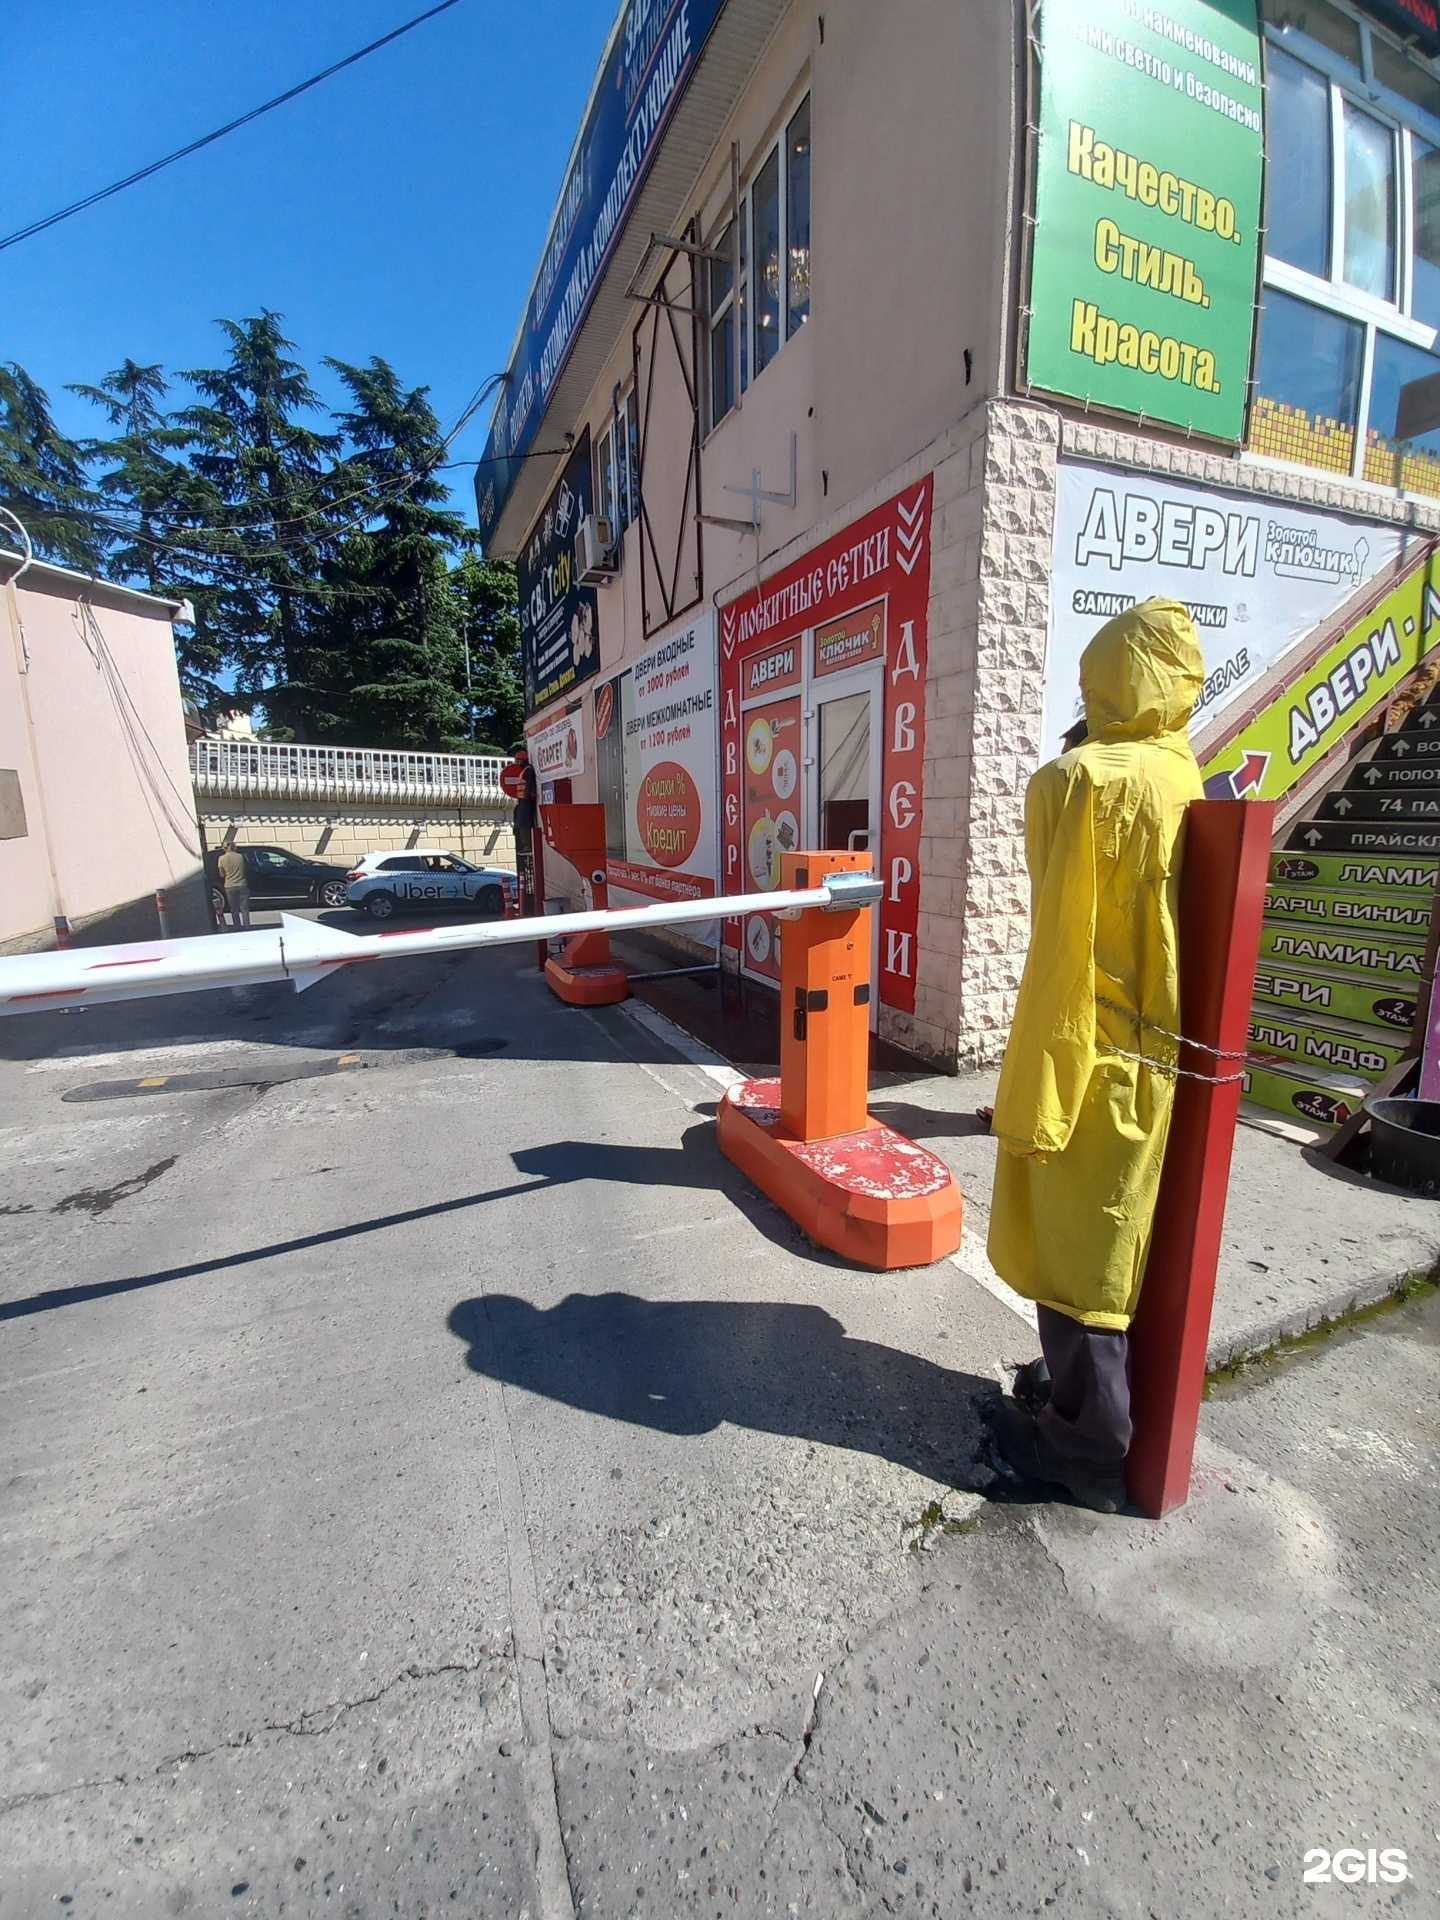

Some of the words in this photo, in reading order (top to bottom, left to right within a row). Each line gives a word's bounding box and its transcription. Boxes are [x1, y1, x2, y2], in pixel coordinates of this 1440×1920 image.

[1143, 7, 1256, 87] наименований
[1116, 38, 1171, 84] светло
[1172, 67, 1184, 93] и
[1186, 70, 1260, 133] безопасно
[1067, 119, 1242, 245] Качество.
[1094, 217, 1211, 309] Стиль.
[539, 244, 593, 397] АВТОМАТИКА
[1069, 298, 1221, 395] Красота.
[1075, 488, 1260, 578] ДВЕРИ
[1267, 520, 1317, 546] Золотой
[1265, 540, 1354, 575] КЛЮЧИК
[738, 567, 824, 643] МОСКИТНЫЕ
[827, 526, 891, 597] СЕТКИ
[1072, 589, 1136, 617] ЗАМКИ
[1180, 602, 1227, 628] УЧКИ
[635, 655, 656, 681] ДВЕРИ
[657, 630, 694, 668] ВХОДНЫЕ
[820, 630, 869, 661] КЛЮЧИК
[665, 661, 690, 689] рублей
[750, 647, 794, 689] ДВЕРИ
[1288, 617, 1400, 765] ДВЕРИ
[625, 719, 646, 736] ДВЕРИ
[646, 689, 713, 729] МЕЖКОМНАТНЫЕ
[666, 723, 692, 746] рублей
[646, 776, 675, 799] Скидки
[667, 805, 688, 819] цены
[1379, 799, 1403, 813] 74
[647, 821, 688, 857] Кредит
[1290, 870, 1315, 879] ЭТАЖ
[1297, 861, 1304, 871] 2
[393, 881, 443, 899] Uber
[671, 879, 702, 897] партнера
[1272, 936, 1426, 975] ЛАМИНА
[1376, 1008, 1410, 1025] ЭТАЖ
[1395, 1002, 1405, 1012] 2
[1305, 1037, 1387, 1071] МДФ
[1296, 1101, 1329, 1121] ЭТАЖ
[1313, 1095, 1322, 1108] 2
